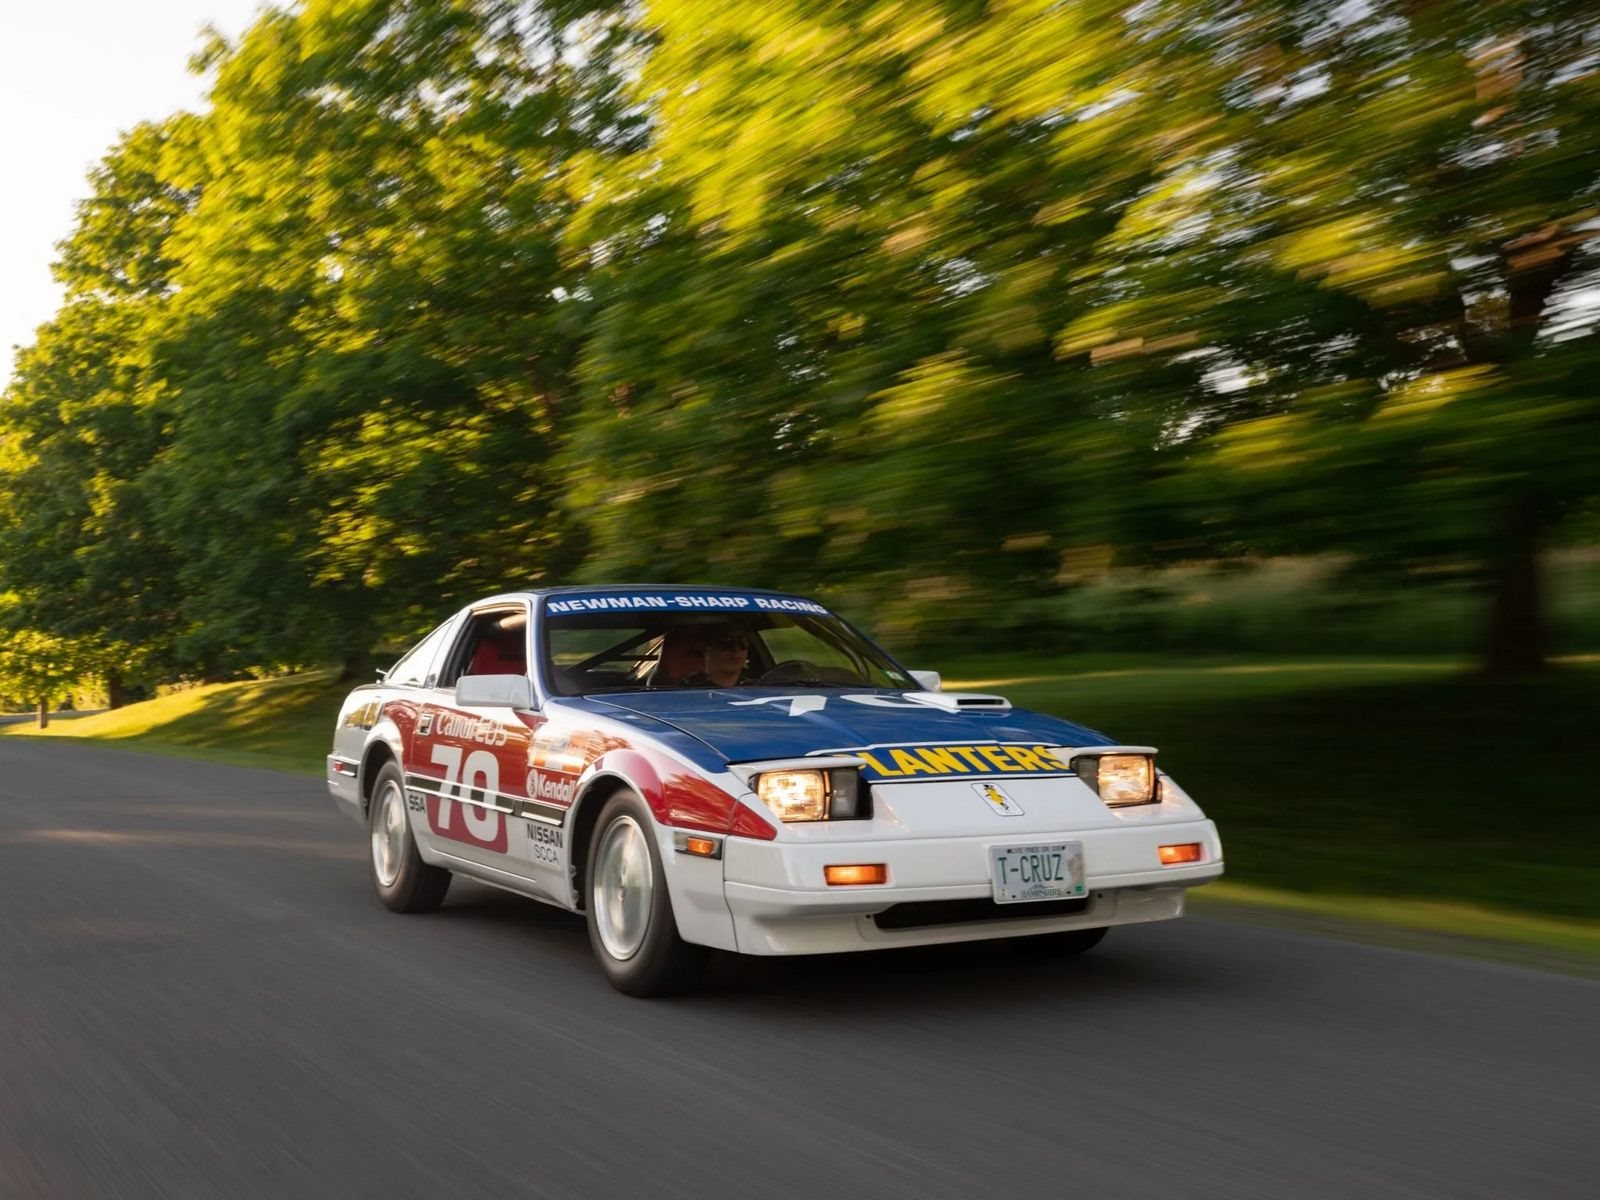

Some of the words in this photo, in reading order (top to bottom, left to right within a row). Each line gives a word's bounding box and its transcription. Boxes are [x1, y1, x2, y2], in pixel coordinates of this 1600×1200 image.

[547, 596, 749, 613] NEWMAN-SHARP
[753, 598, 828, 614] RACING
[431, 744, 499, 842] 70
[537, 774, 576, 803] Kendall
[526, 823, 563, 848] NISSAN
[998, 853, 1064, 885] T-CRUZ
